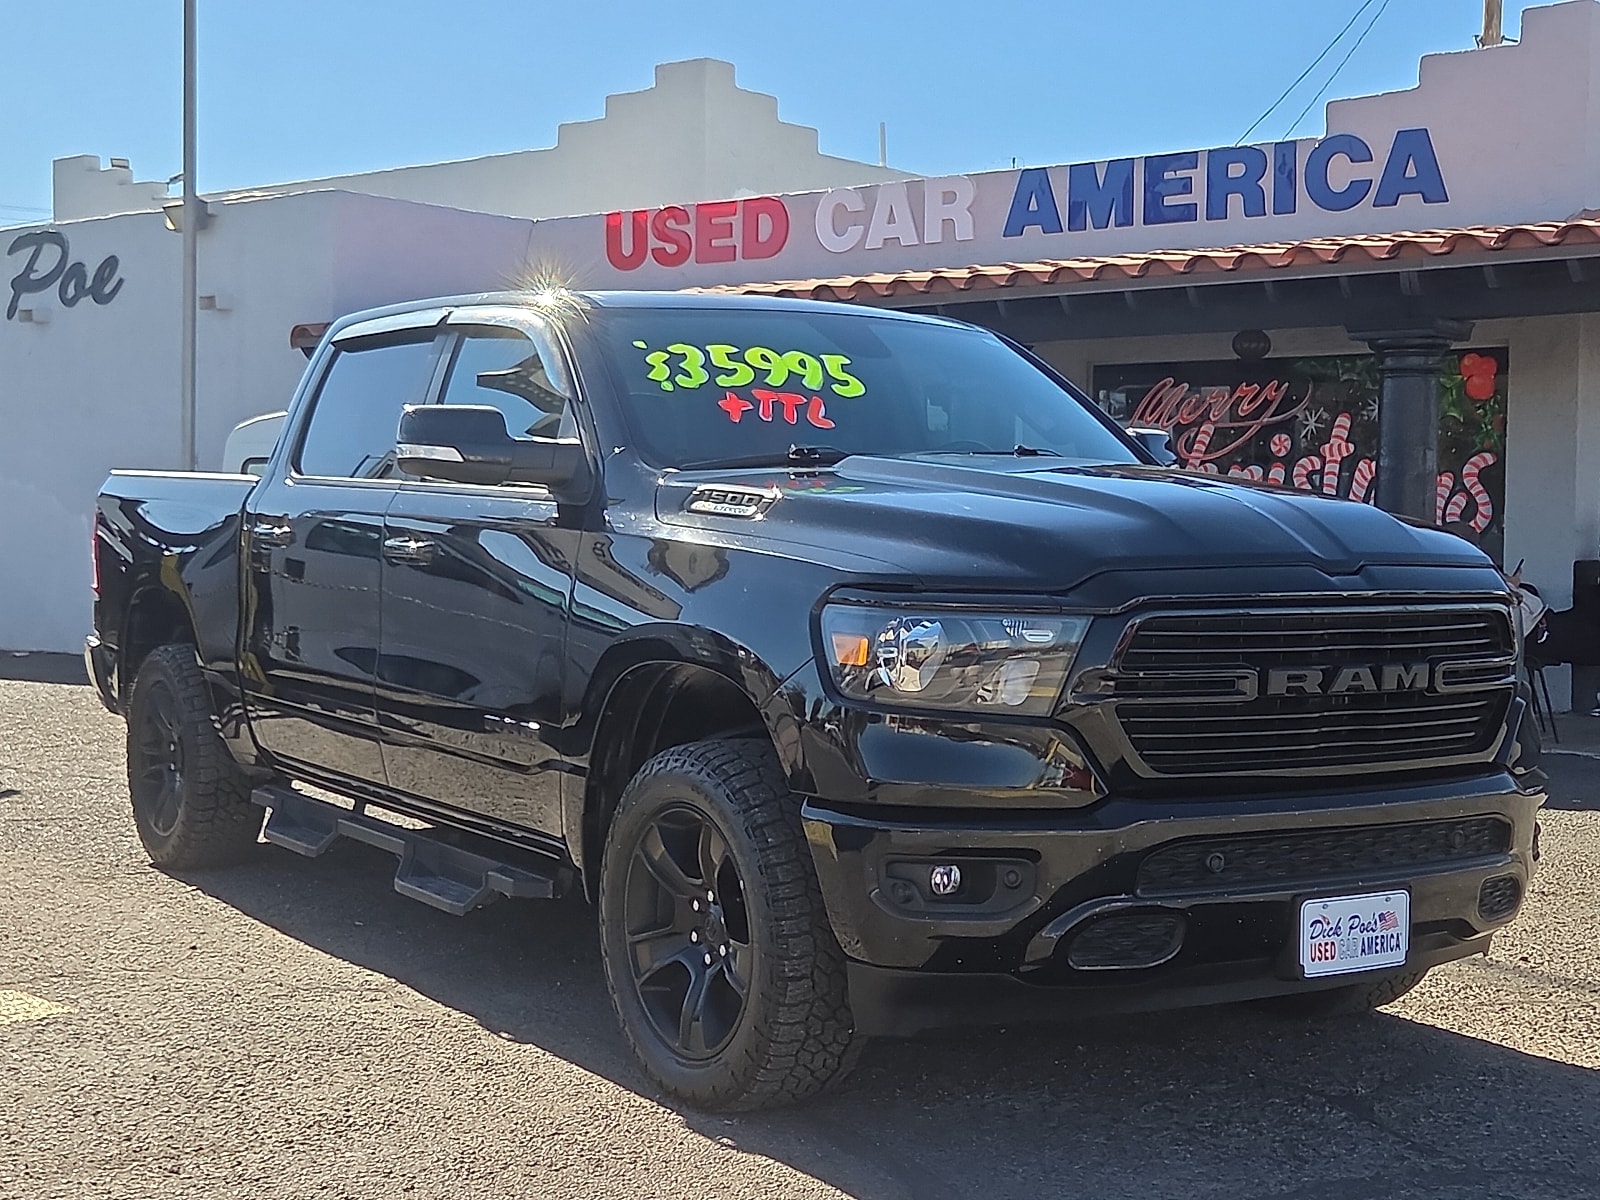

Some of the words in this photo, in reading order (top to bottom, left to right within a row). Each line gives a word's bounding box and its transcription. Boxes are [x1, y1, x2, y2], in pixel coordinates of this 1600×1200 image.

[605, 196, 790, 271] USED
[815, 175, 975, 252] CAR
[1003, 128, 1449, 238] AMERICA
[7, 231, 125, 320] Poe
[632, 340, 866, 397] $35995
[1129, 376, 1311, 460] Merry
[702, 489, 760, 506] 1500
[1267, 662, 1429, 696] RAM
[1309, 917, 1342, 940] Dick
[1347, 911, 1378, 936] Poe's
[1310, 941, 1336, 962] USED
[1360, 932, 1401, 957] AMERICA
